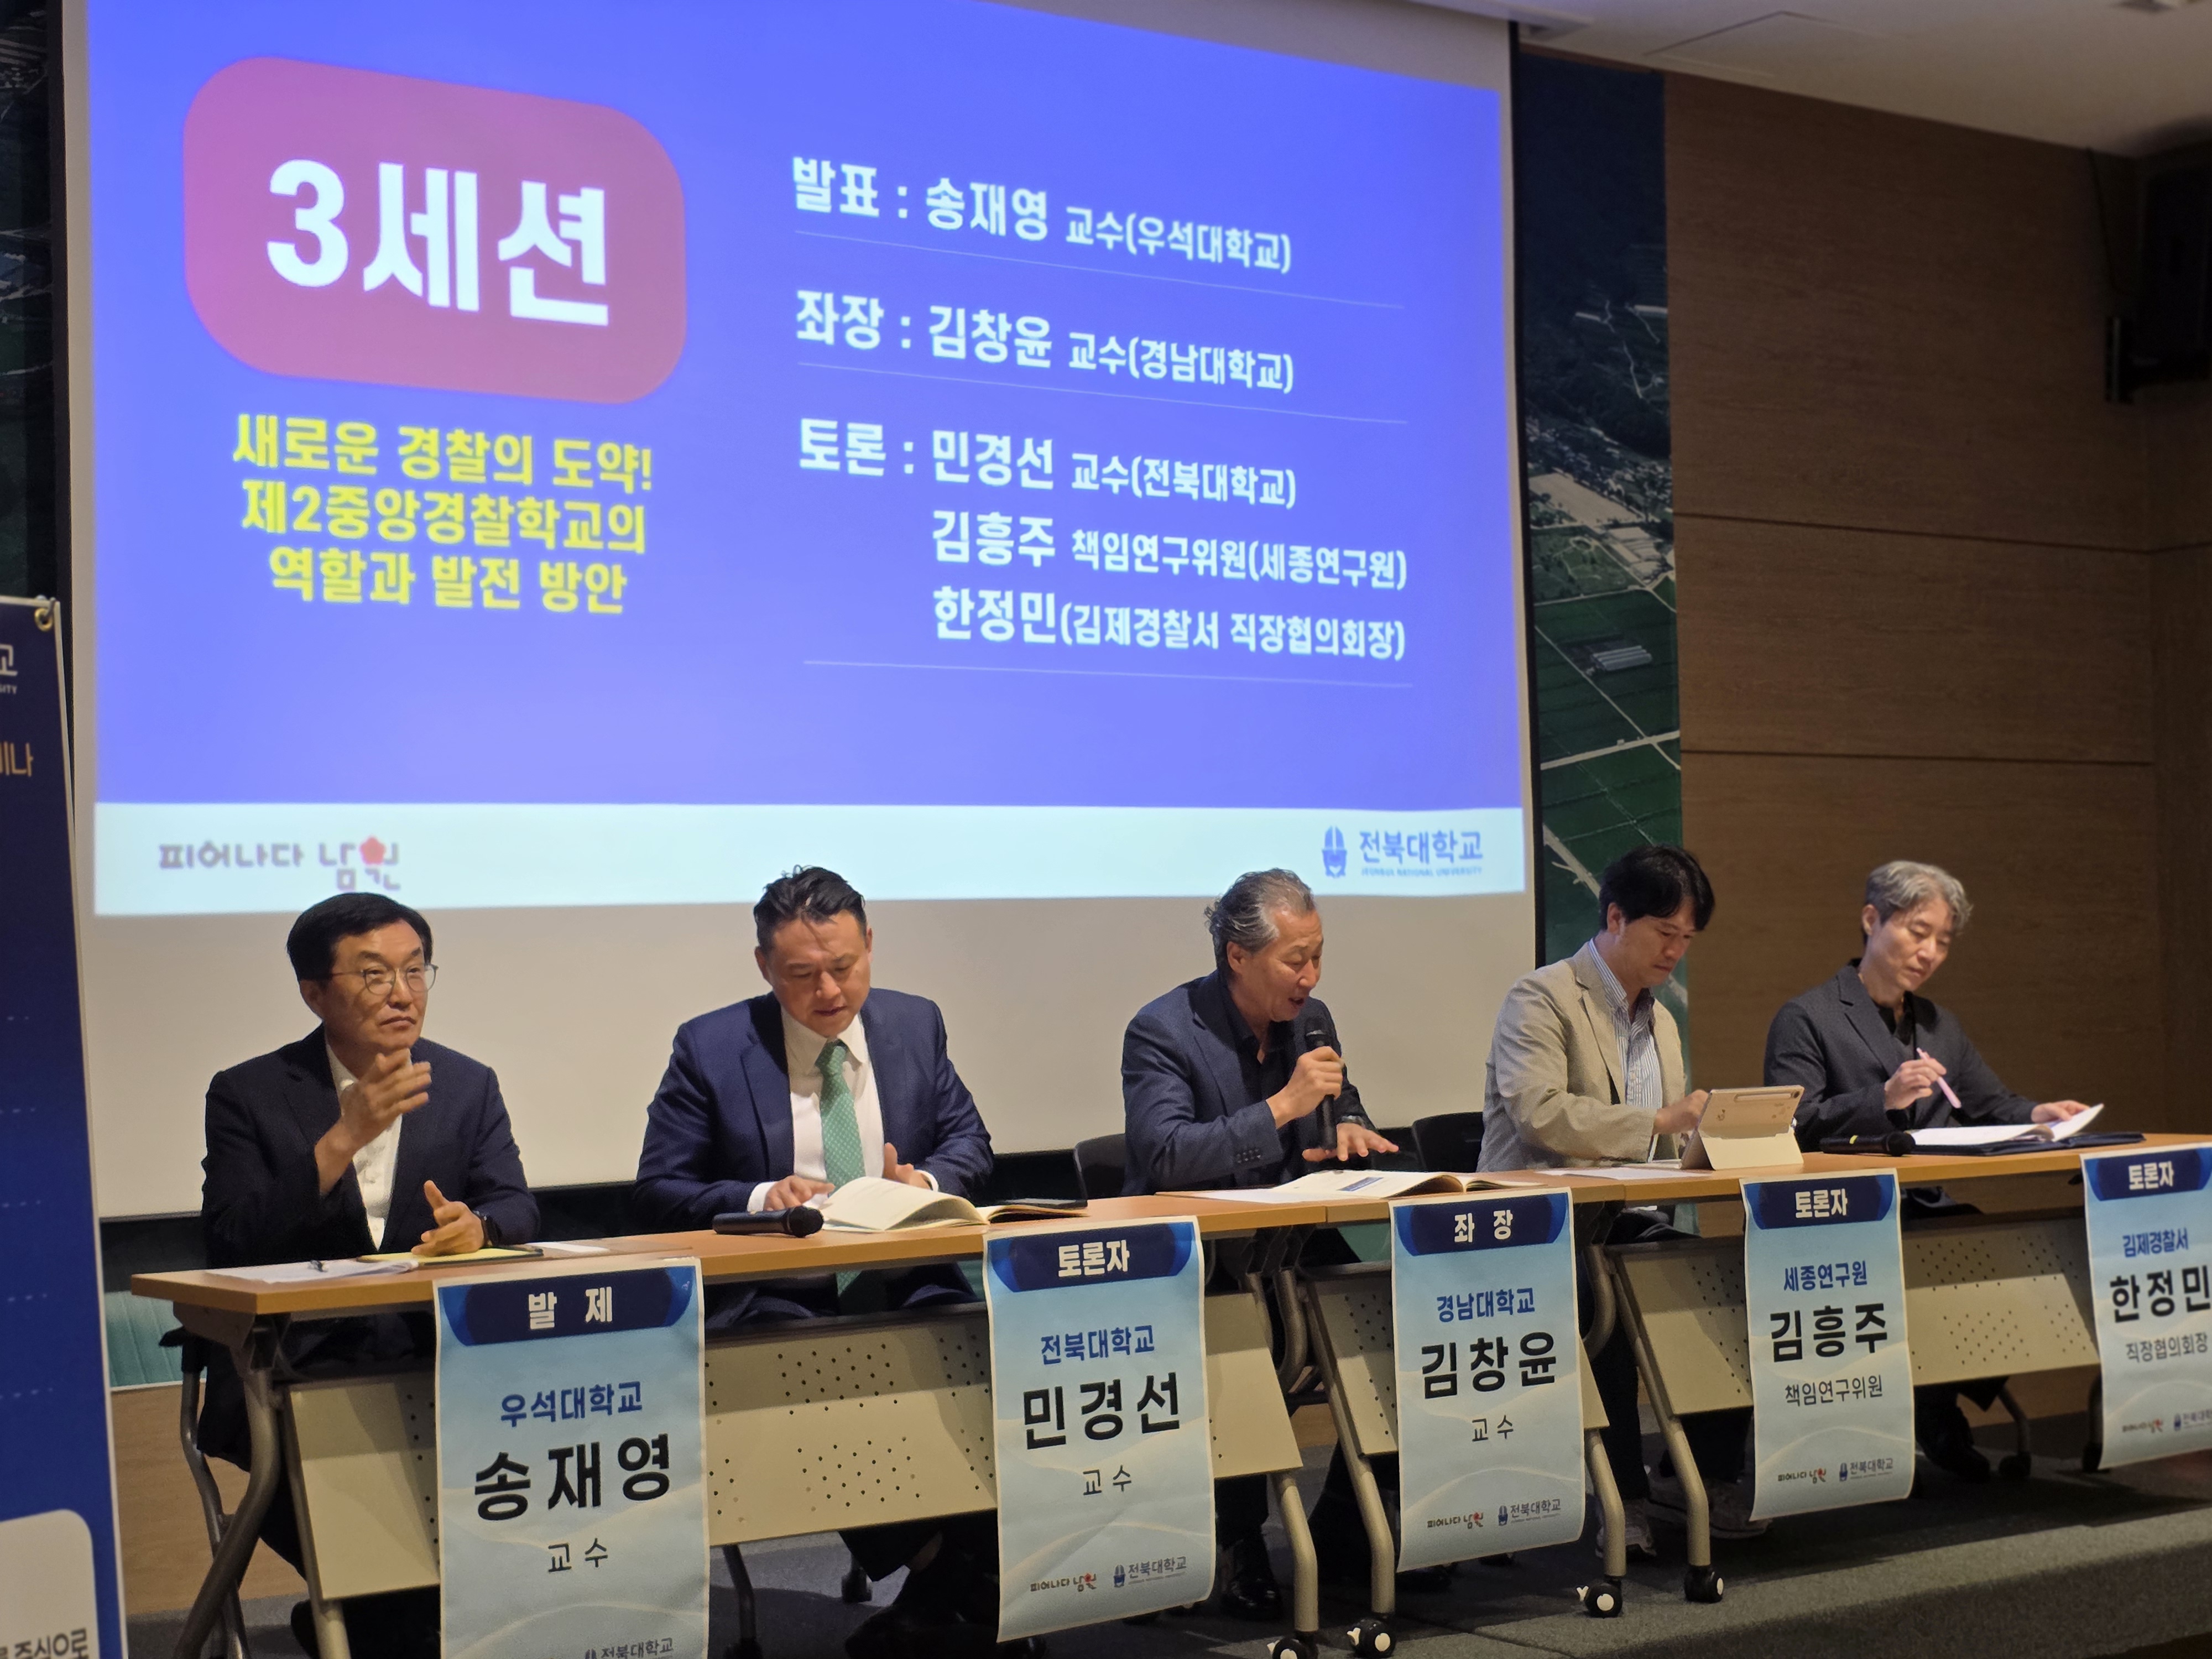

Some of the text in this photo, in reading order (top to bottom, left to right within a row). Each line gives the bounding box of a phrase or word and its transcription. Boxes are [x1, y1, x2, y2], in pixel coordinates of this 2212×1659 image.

[793, 156, 880, 217] 발표
[926, 177, 1048, 241] 송재영
[1066, 206, 1291, 273] 교수(우석대학교)
[267, 159, 609, 326] 3세션
[796, 289, 885, 349] 좌장
[929, 305, 1052, 368] 김창윤
[1068, 332, 1293, 394] 교수(경남대학교)
[233, 413, 653, 494] 새로운 경찰의 도약!
[799, 418, 886, 477] 토론
[932, 429, 1054, 490] 민경선
[1071, 452, 1296, 509] 교수(전북대학교)
[241, 479, 645, 554] 제2중앙경찰학교의
[932, 509, 1407, 590] 김흥주 책임연구위원(세종연구원)
[269, 546, 628, 614] 역할과 발전 방안
[933, 585, 1405, 661] 한정민(김제경찰서 직장협의회장)
[159, 839, 304, 870] 피어나다
[1359, 829, 1483, 864] 전북대학교
[2128, 1161, 2174, 1190] 토론자
[1795, 1188, 1848, 1218] 토론자
[1058, 1239, 1130, 1277] 토론자
[2122, 1228, 2189, 1258] 김제경찰서
[1783, 1260, 1867, 1292] 세종연구원
[2110, 1265, 2211, 1323] 한정민
[1437, 1287, 1535, 1323] 경남대학교
[1041, 1324, 1155, 1365] 전북대학교
[1770, 1303, 1887, 1363] 김흥주
[2126, 1332, 2208, 1363] 직장협의회장
[1421, 1332, 1557, 1399] 김창윤
[500, 1381, 643, 1427] 우석대학교
[1785, 1375, 1883, 1407] 책임연구위원
[1023, 1372, 1180, 1450] 민경선
[1472, 1415, 1514, 1442] 교수
[474, 1433, 670, 1521] 송재영
[1083, 1465, 1132, 1496] 교수
[1850, 1458, 1893, 1475] 전북대학교
[1427, 1516, 1461, 1528] 피어나다
[1510, 1498, 1562, 1519] 전북대학교
[548, 1538, 608, 1573] 교수
[1128, 1556, 1187, 1579] 전북대학교
[1030, 1578, 1070, 1593] 피어나다
